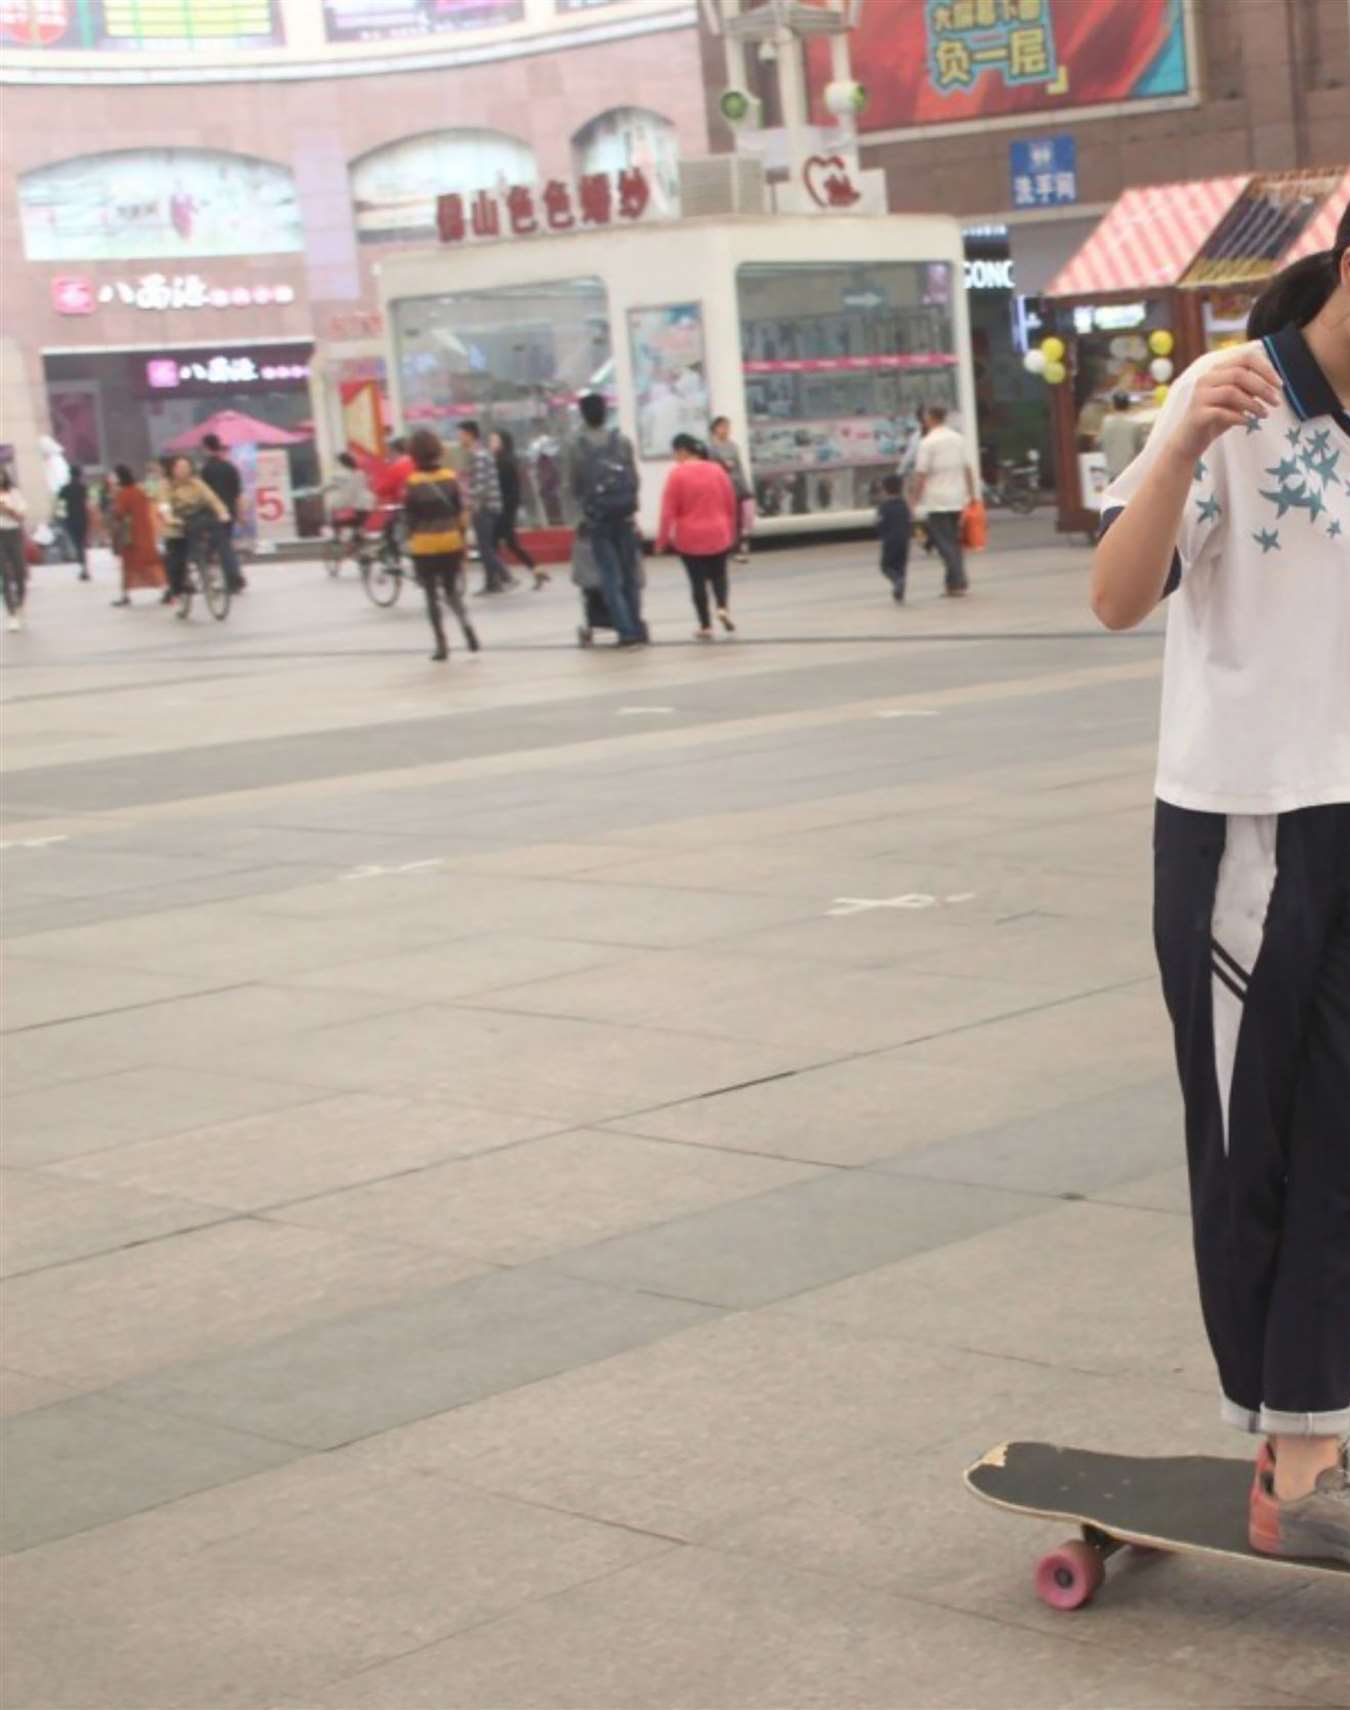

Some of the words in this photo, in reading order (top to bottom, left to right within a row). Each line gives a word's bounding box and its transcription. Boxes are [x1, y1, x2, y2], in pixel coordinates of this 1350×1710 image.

[936, 28, 1047, 85] 负一层
[1014, 171, 1076, 205] 洗手间
[256, 488, 284, 521] 5
